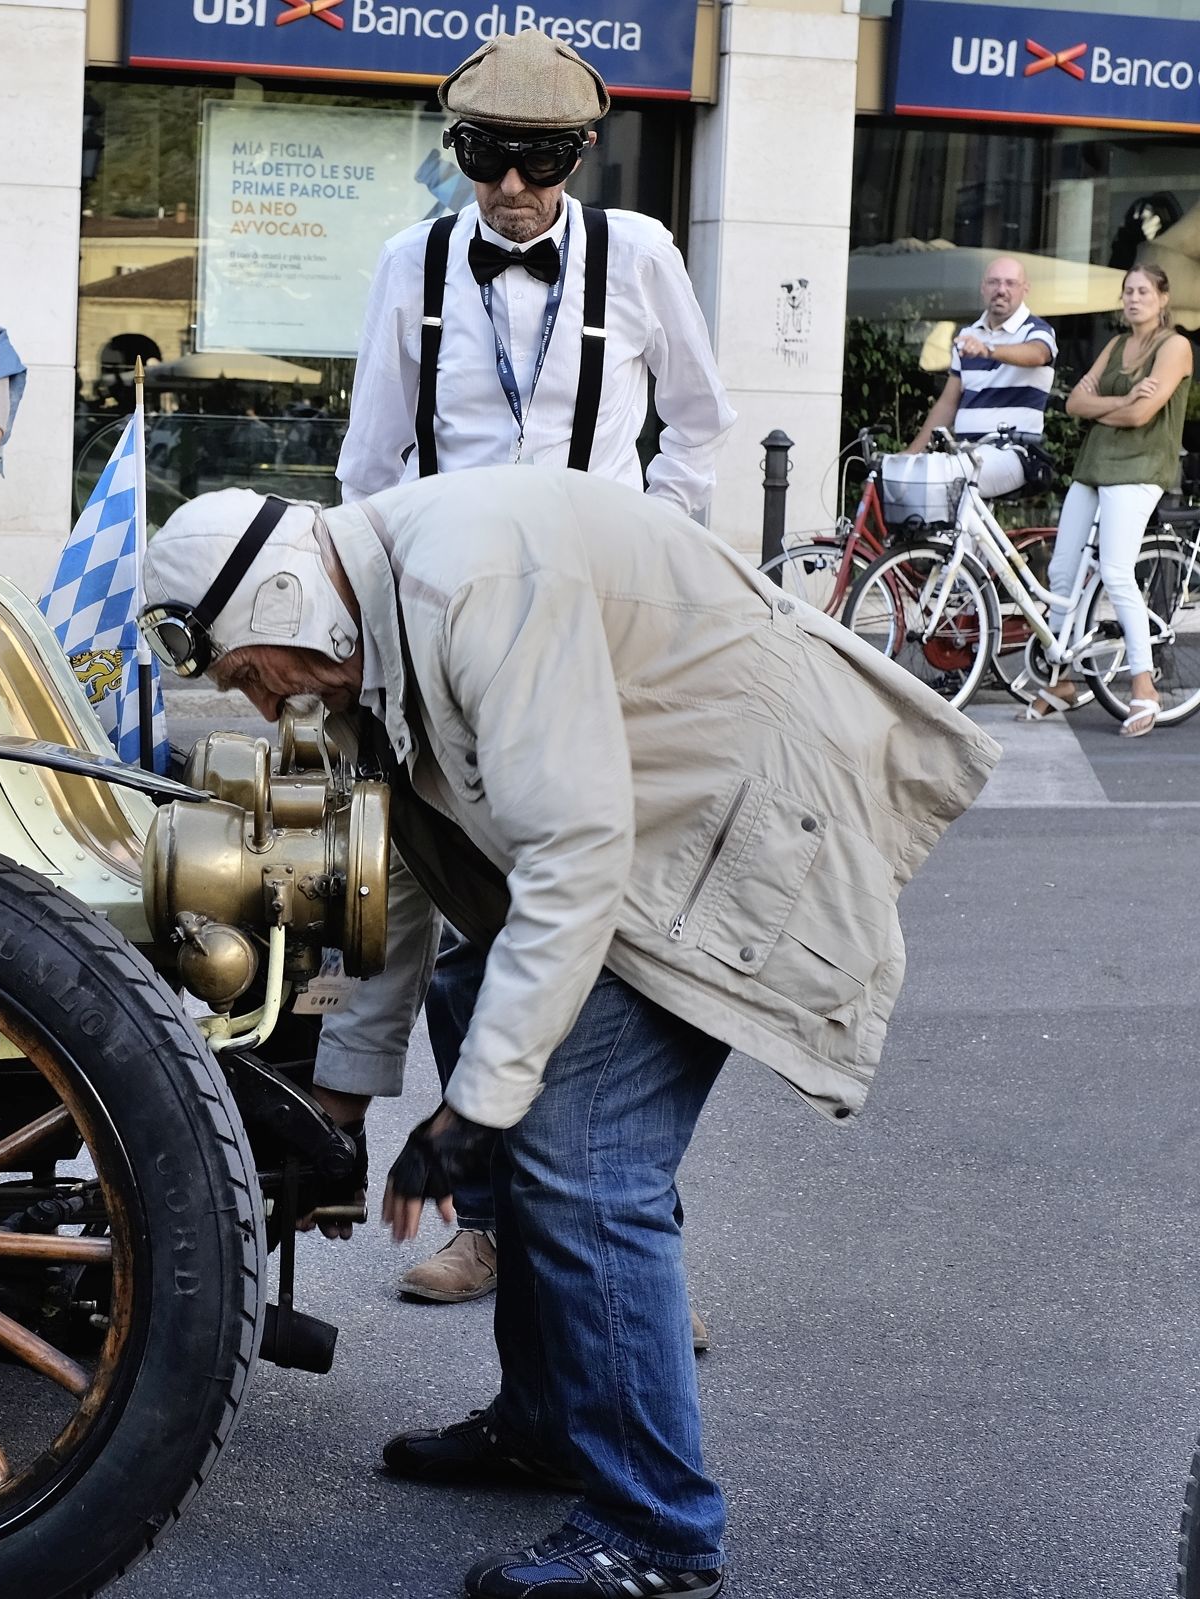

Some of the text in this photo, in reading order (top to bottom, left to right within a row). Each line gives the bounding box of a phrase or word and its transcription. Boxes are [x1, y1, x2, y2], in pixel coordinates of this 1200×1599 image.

[193, 0, 642, 51] UBI Banco di Brescia
[952, 36, 1194, 90] UBI Banco
[232, 142, 325, 159] MIA FIGLIA
[232, 161, 375, 181] HA DETTO LE SUE
[232, 181, 360, 200] PRIME PAROLE.
[232, 200, 297, 217] DA NEO
[230, 221, 327, 238] AVVOCATO.
[155, 1153, 201, 1296] CORD
